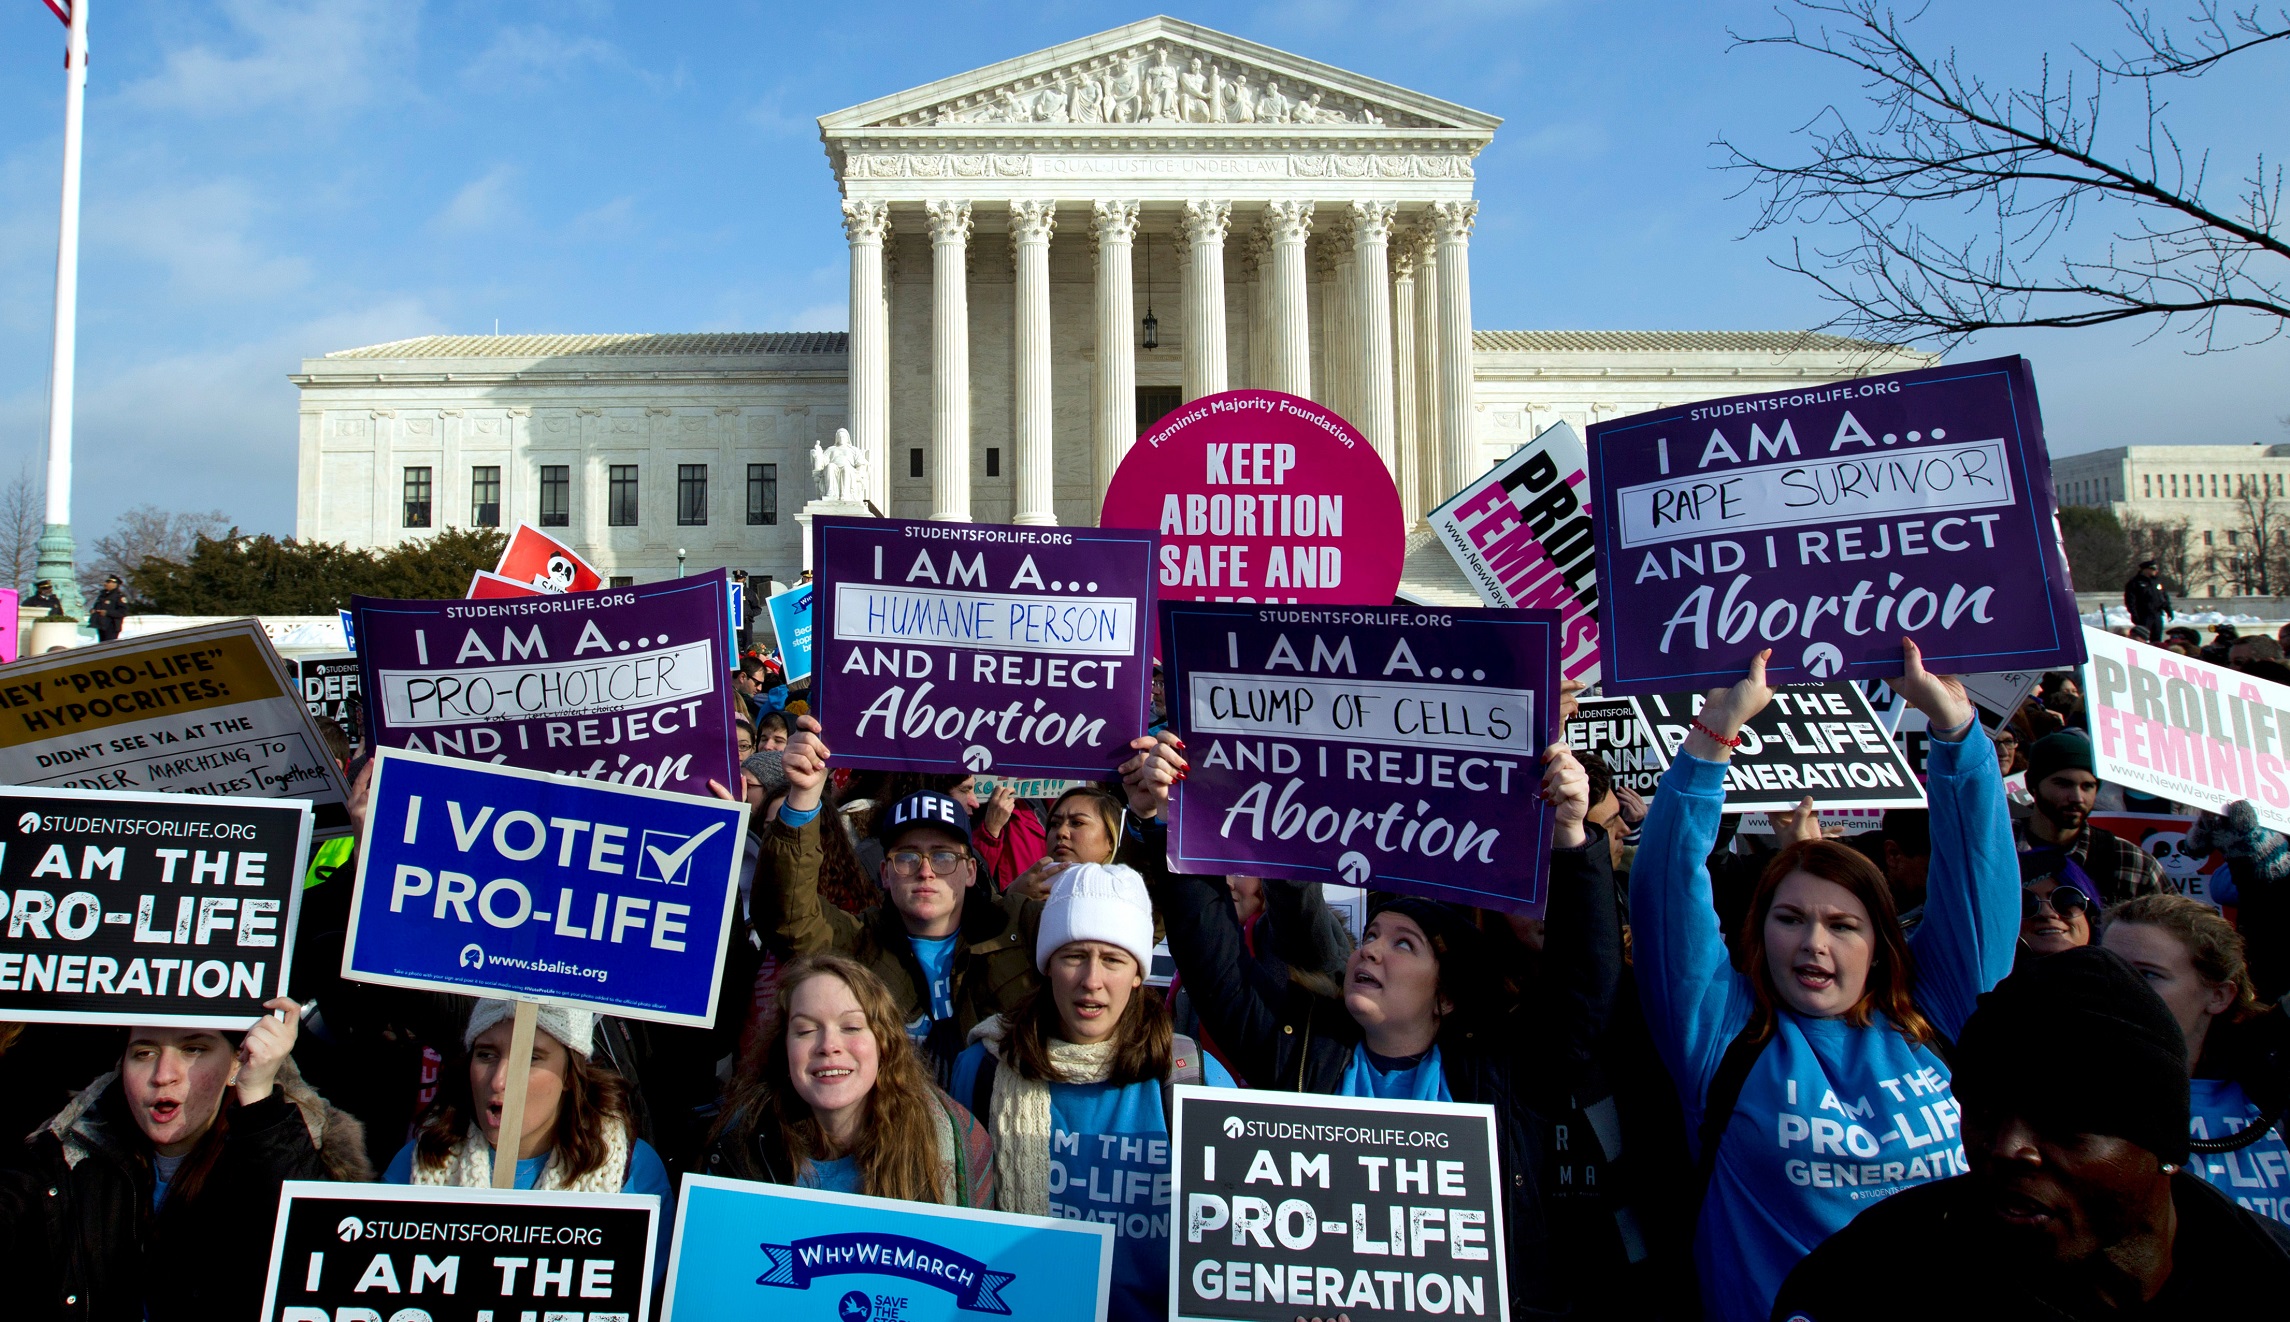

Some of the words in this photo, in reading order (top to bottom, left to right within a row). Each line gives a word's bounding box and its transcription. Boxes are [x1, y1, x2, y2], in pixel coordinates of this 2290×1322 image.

[1043, 160, 1105, 173] EQUAL
[1109, 160, 1174, 173] JUSTICE
[1182, 160, 1240, 173] UNDER
[1247, 160, 1280, 173] LAW
[1149, 406, 1209, 448] Feminist
[1211, 397, 1276, 414] Majority
[1279, 399, 1355, 449] Foundation
[1690, 380, 1901, 421] STUDENTSFORLIFE.ORG
[1206, 443, 1296, 485] KEEP
[1657, 438, 1670, 475] I
[1698, 418, 1802, 468] AM
[1829, 410, 1947, 451] A...
[1651, 478, 1746, 529] RAPE
[1780, 449, 1994, 507] SURVIVOR
[904, 526, 1073, 545] STUDENTSFORLIFE.ORG
[1160, 494, 1343, 537] ABORTION
[874, 545, 883, 580] I
[906, 548, 988, 588] AM
[1010, 554, 1098, 592] A...
[1159, 545, 1249, 587] SAFE
[1265, 546, 1343, 588] AND
[1635, 540, 1746, 585] AND
[1766, 535, 1778, 568] I
[1800, 514, 2001, 566] REJECT
[447, 592, 636, 619] STUDENTSFORLIFE.ORG
[868, 595, 994, 641] HUMANE
[1010, 603, 1117, 643] PERSON
[1259, 610, 1453, 627] STUDENTSFORLIFE.ORG
[1659, 571, 1996, 654] Abortion
[415, 629, 429, 665] I
[456, 624, 549, 664] AM
[574, 619, 669, 655] A...
[1228, 632, 1239, 668] I
[1265, 633, 1357, 674] AM
[1382, 637, 1486, 681] A...
[842, 646, 933, 679] AND
[948, 652, 956, 681] I
[973, 654, 1122, 689] REJECT
[2126, 647, 2138, 667] I
[2158, 658, 2219, 692] AM
[2239, 681, 2264, 705] A
[22, 679, 231, 733] HYPOCRITES:
[402, 728, 503, 756] AND
[518, 725, 529, 750] I
[546, 700, 702, 748] REJECT
[591, 704, 625, 715] choices
[856, 682, 1107, 748] Abortion
[1209, 686, 1314, 727] CLUMP
[1332, 694, 1382, 730] OF
[1394, 698, 1513, 740] CELLS
[1652, 694, 1670, 717] I
[35, 743, 104, 769] DIDN'T
[111, 734, 149, 753] SEE
[151, 728, 179, 746] YA
[185, 724, 205, 741] AT
[208, 716, 253, 737] THE
[148, 747, 251, 781] MARCHING
[255, 742, 286, 758] TO
[2097, 703, 2290, 809] FEMINIS
[1203, 739, 1301, 775] AND
[1319, 746, 1327, 777] I
[1347, 748, 1518, 794] REJECT
[42, 815, 257, 840] STUDENTSFORLIFE.ORG
[894, 796, 955, 824] LIFE
[1220, 777, 1501, 863] Abortion
[403, 795, 422, 845] I
[446, 800, 629, 875] VOTE
[31, 844, 126, 881] AM
[155, 848, 268, 886] THE
[0, 889, 280, 947] RO-LIFE
[389, 864, 691, 953] PRO-LIFE
[488, 953, 608, 983] www.sbalist.org
[580, 992, 594, 1001] photo
[637, 1000, 651, 1008] photo
[1787, 1079, 1797, 1105] I
[1819, 1088, 1875, 1121] AM
[1879, 1065, 1949, 1102] THE
[1098, 1134, 1167, 1165] THE
[1247, 1121, 1449, 1149] STUDENTSFORLIFE.ORG
[1203, 1145, 1215, 1181] I
[1244, 1150, 1330, 1188] AM
[1358, 1156, 1467, 1196] THE
[365, 1220, 603, 1246] STUDENTSFORLIFE.ORG
[1188, 1193, 1489, 1261] PRO-LIFE
[305, 1252, 324, 1292] I
[354, 1253, 461, 1295] AM
[493, 1257, 614, 1298] THE
[1192, 1259, 1485, 1316] GENERATION
[874, 1294, 908, 1309] SAVE
[874, 1305, 899, 1319] THE
